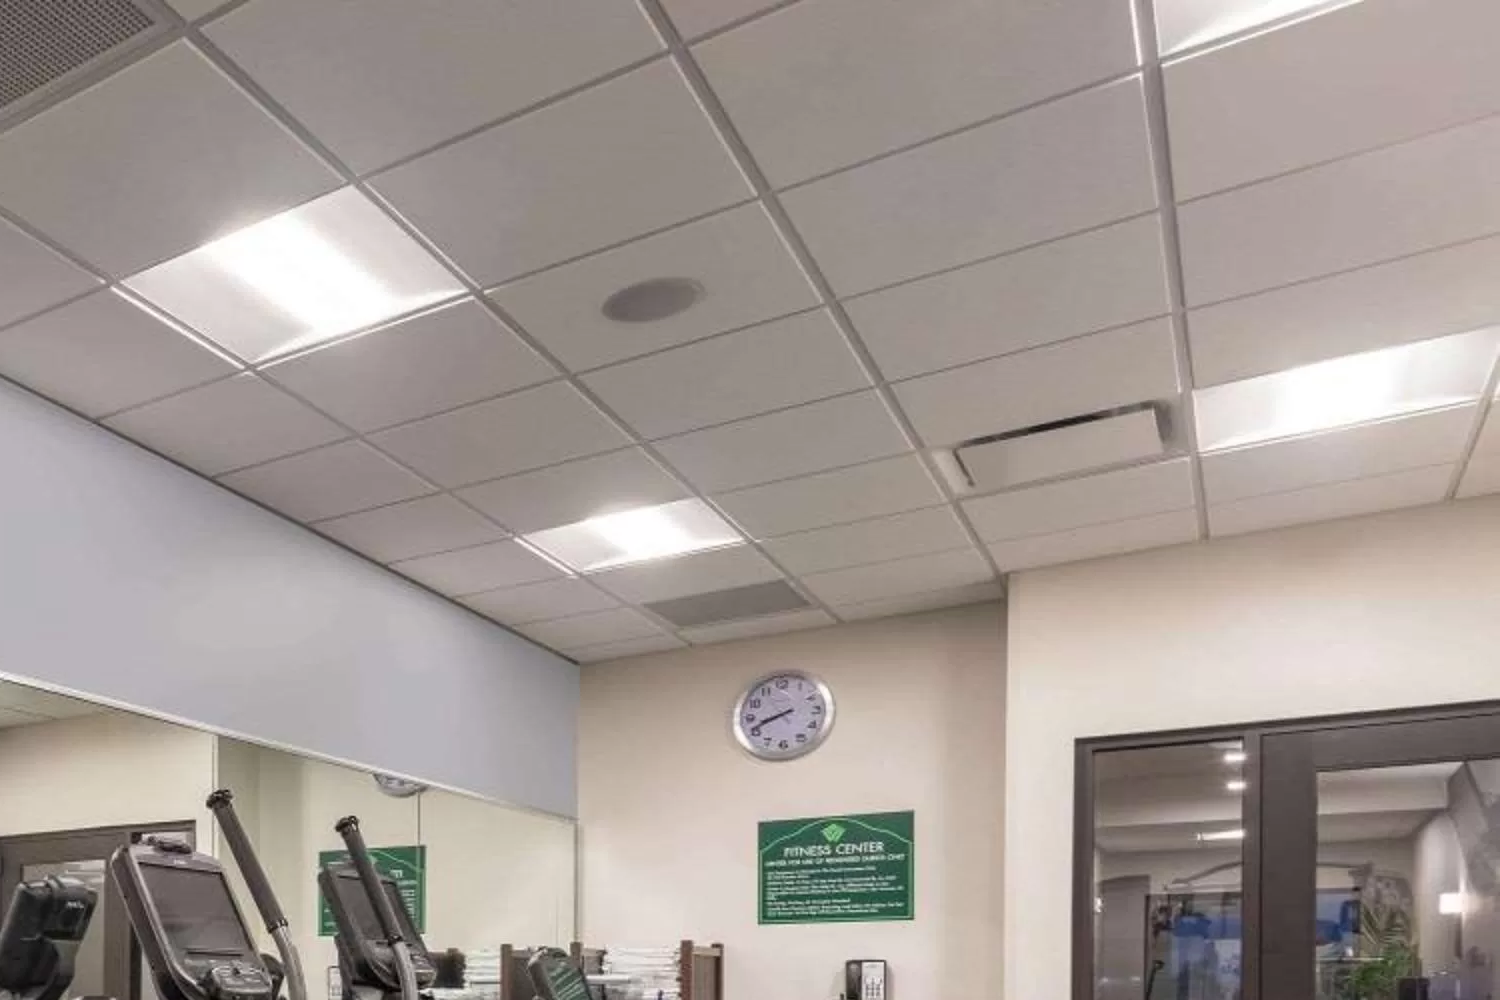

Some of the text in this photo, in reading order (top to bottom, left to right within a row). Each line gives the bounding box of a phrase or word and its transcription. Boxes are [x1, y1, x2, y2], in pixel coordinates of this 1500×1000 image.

[776, 680, 788, 690] 12
[761, 687, 771, 697] 11
[749, 699, 761, 709] 10
[745, 713, 756, 723] 9
[783, 841, 885, 858] FITNESS CENTER
